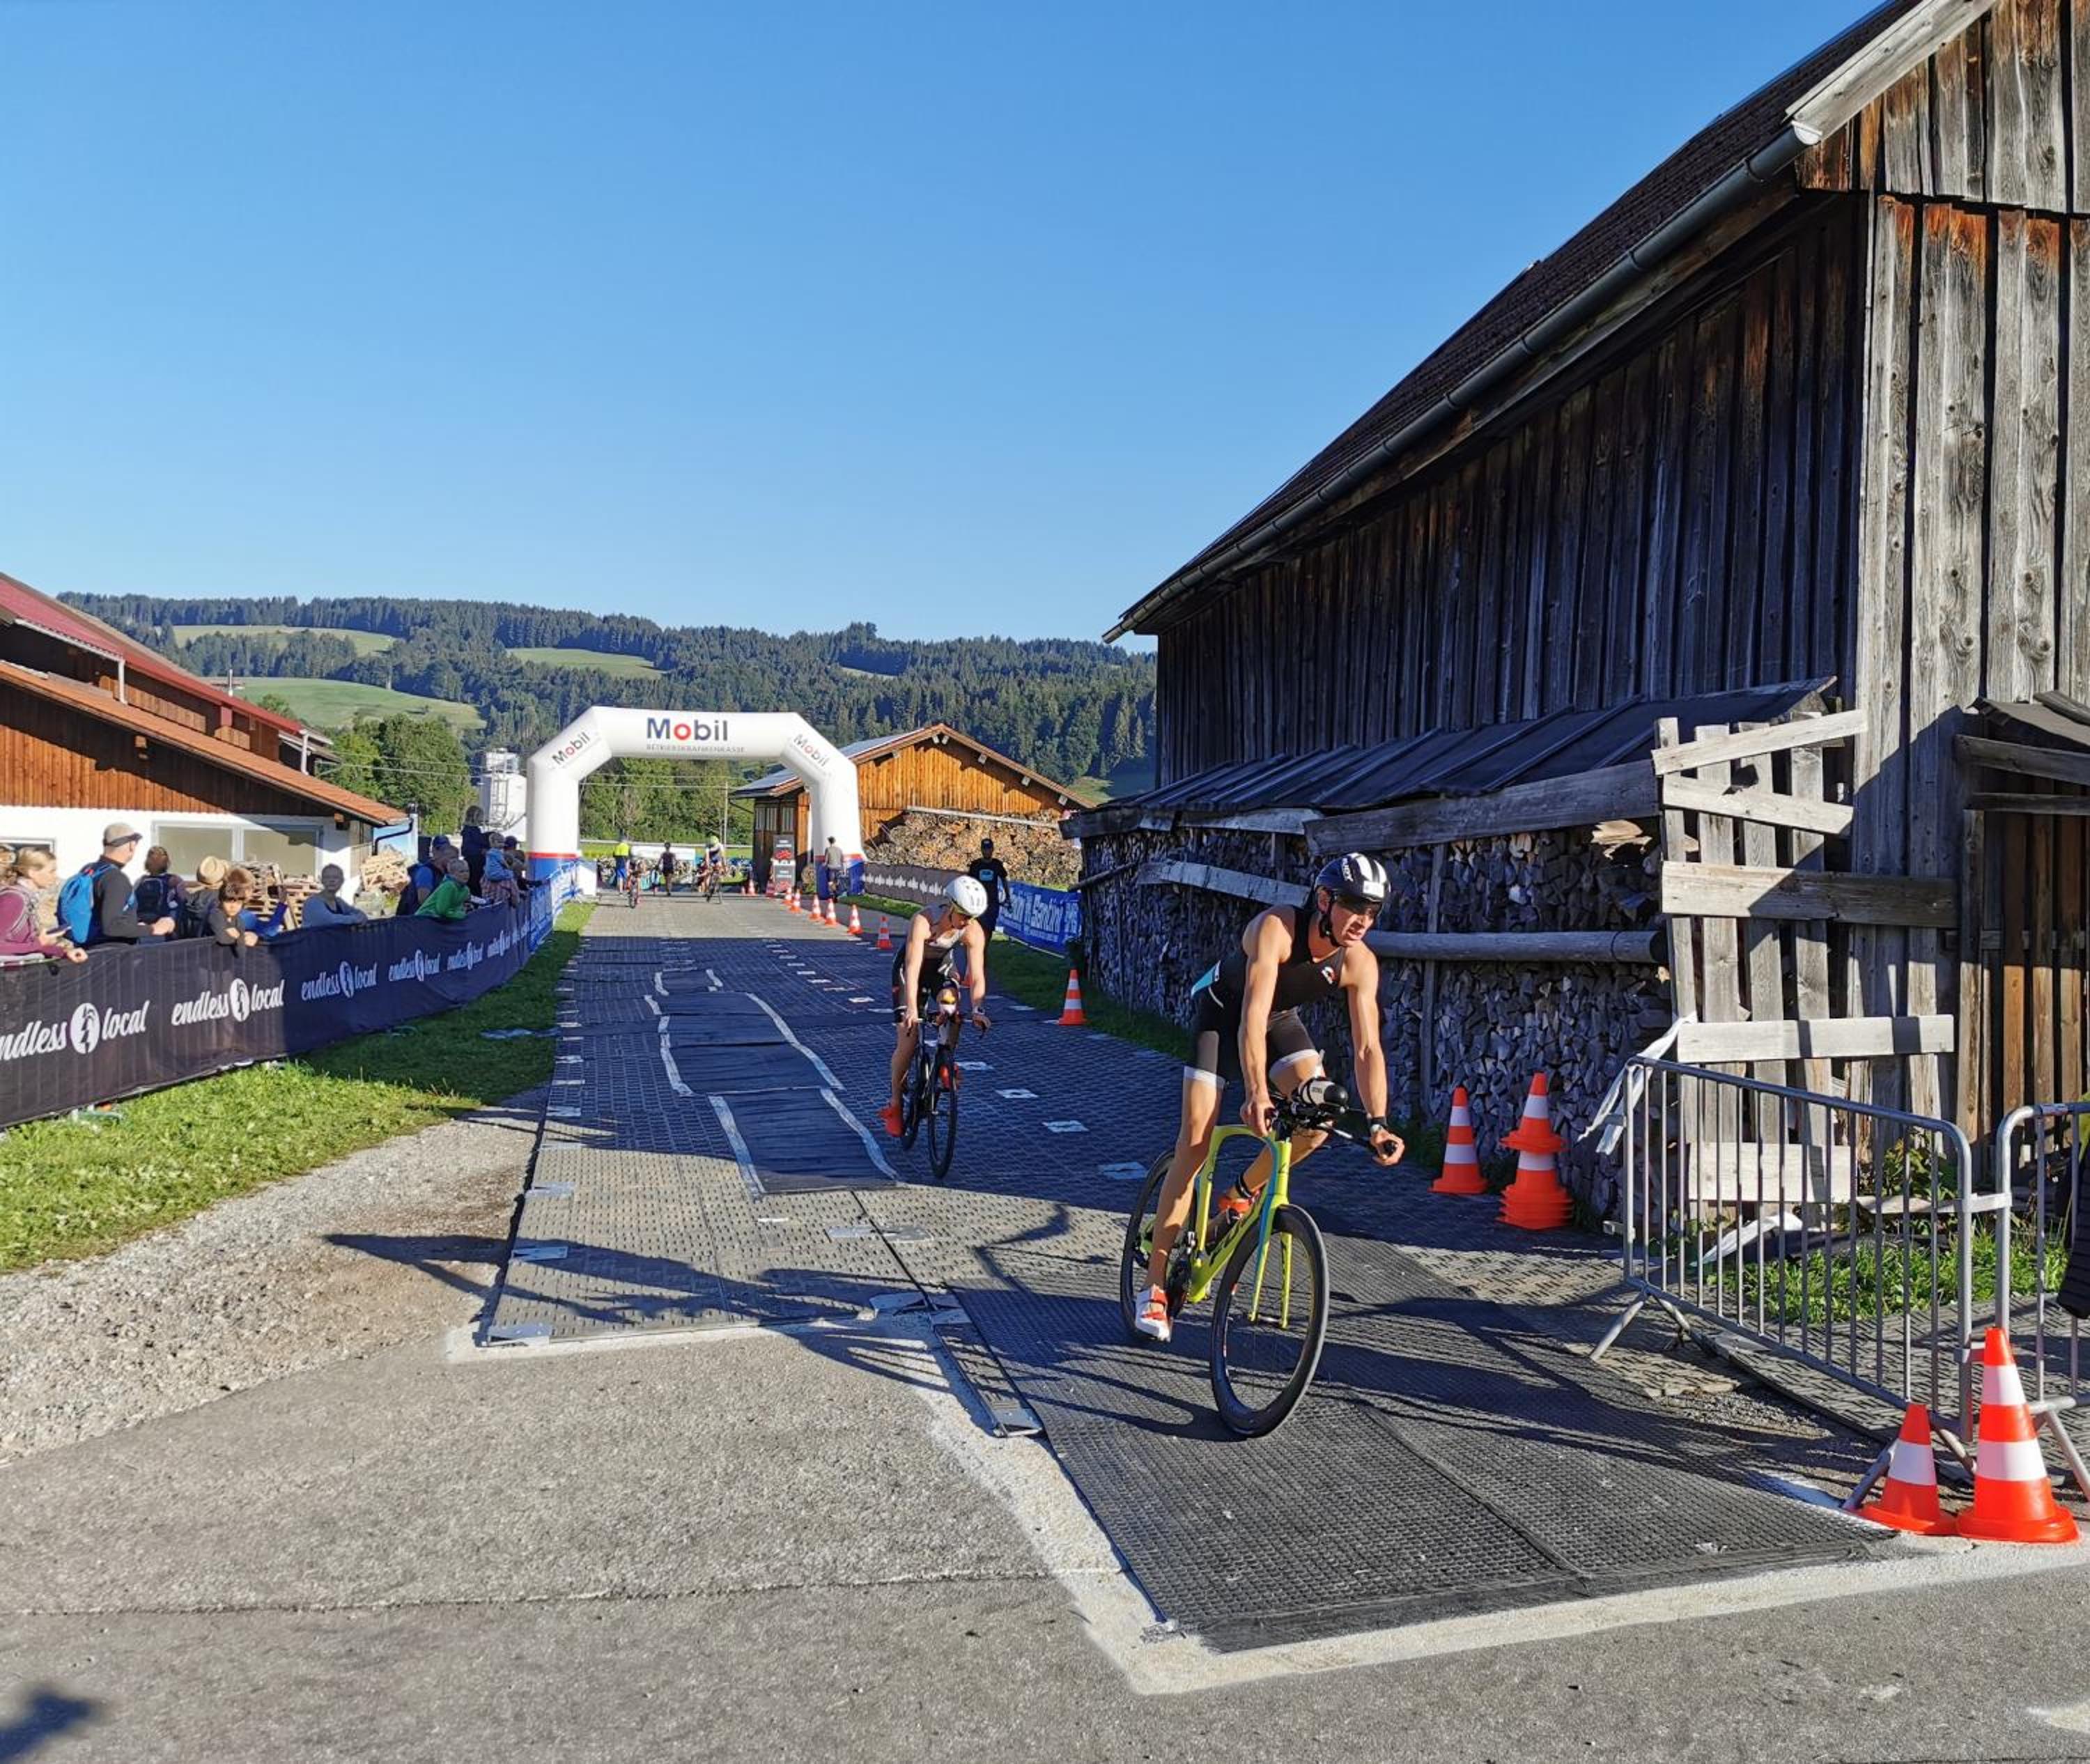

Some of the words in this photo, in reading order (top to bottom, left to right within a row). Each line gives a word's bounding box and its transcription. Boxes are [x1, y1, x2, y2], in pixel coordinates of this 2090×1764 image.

[647, 718, 727, 741] Mobil
[552, 732, 590, 765] Mobil
[794, 734, 830, 766] Mobil
[301, 971, 340, 1001] endless
[355, 962, 377, 989] local
[171, 991, 229, 1026] endless
[251, 979, 285, 1012] local
[0, 1020, 67, 1060] ndless
[102, 1000, 150, 1040] local
